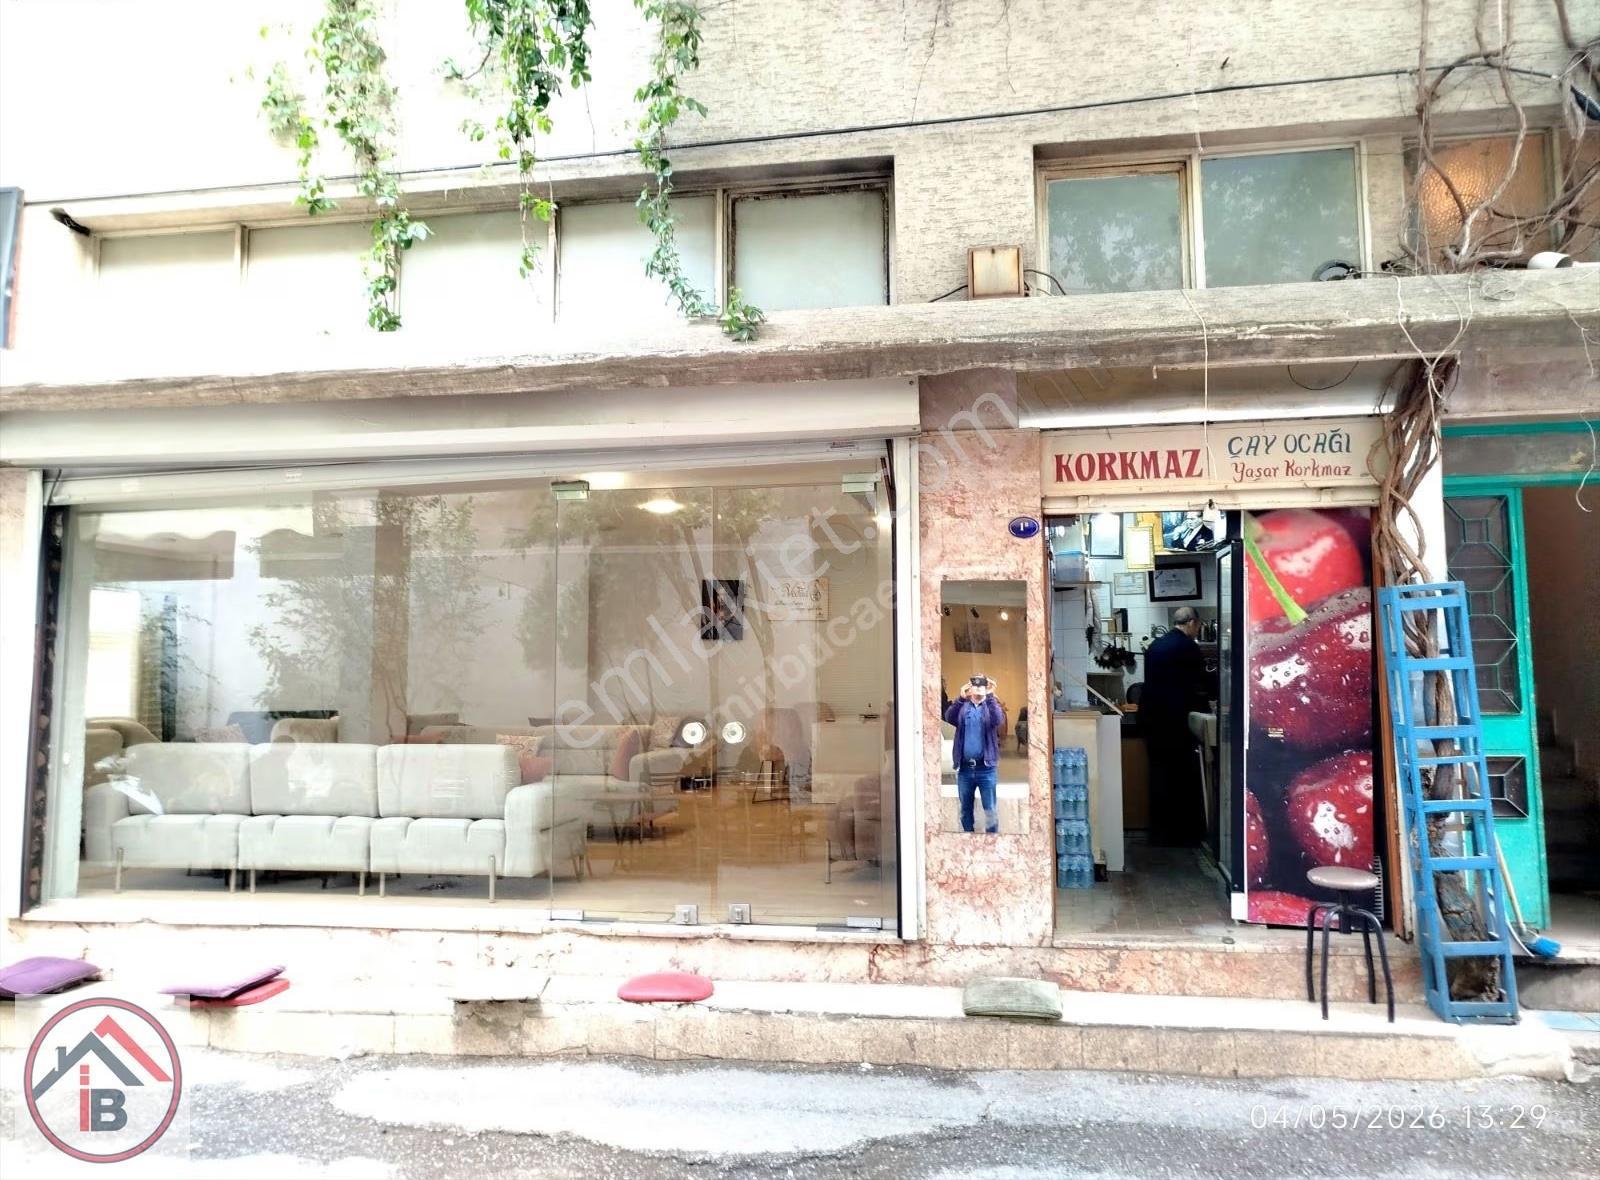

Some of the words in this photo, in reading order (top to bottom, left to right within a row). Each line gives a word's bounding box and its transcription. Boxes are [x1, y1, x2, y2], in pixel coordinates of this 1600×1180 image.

[1227, 435, 1277, 458] ÇAY
[1284, 428, 1351, 454] OCAĞI
[1055, 449, 1203, 483] KORKMAZ
[1232, 462, 1279, 483] Yaşar
[1284, 459, 1352, 477] Korkmaz
